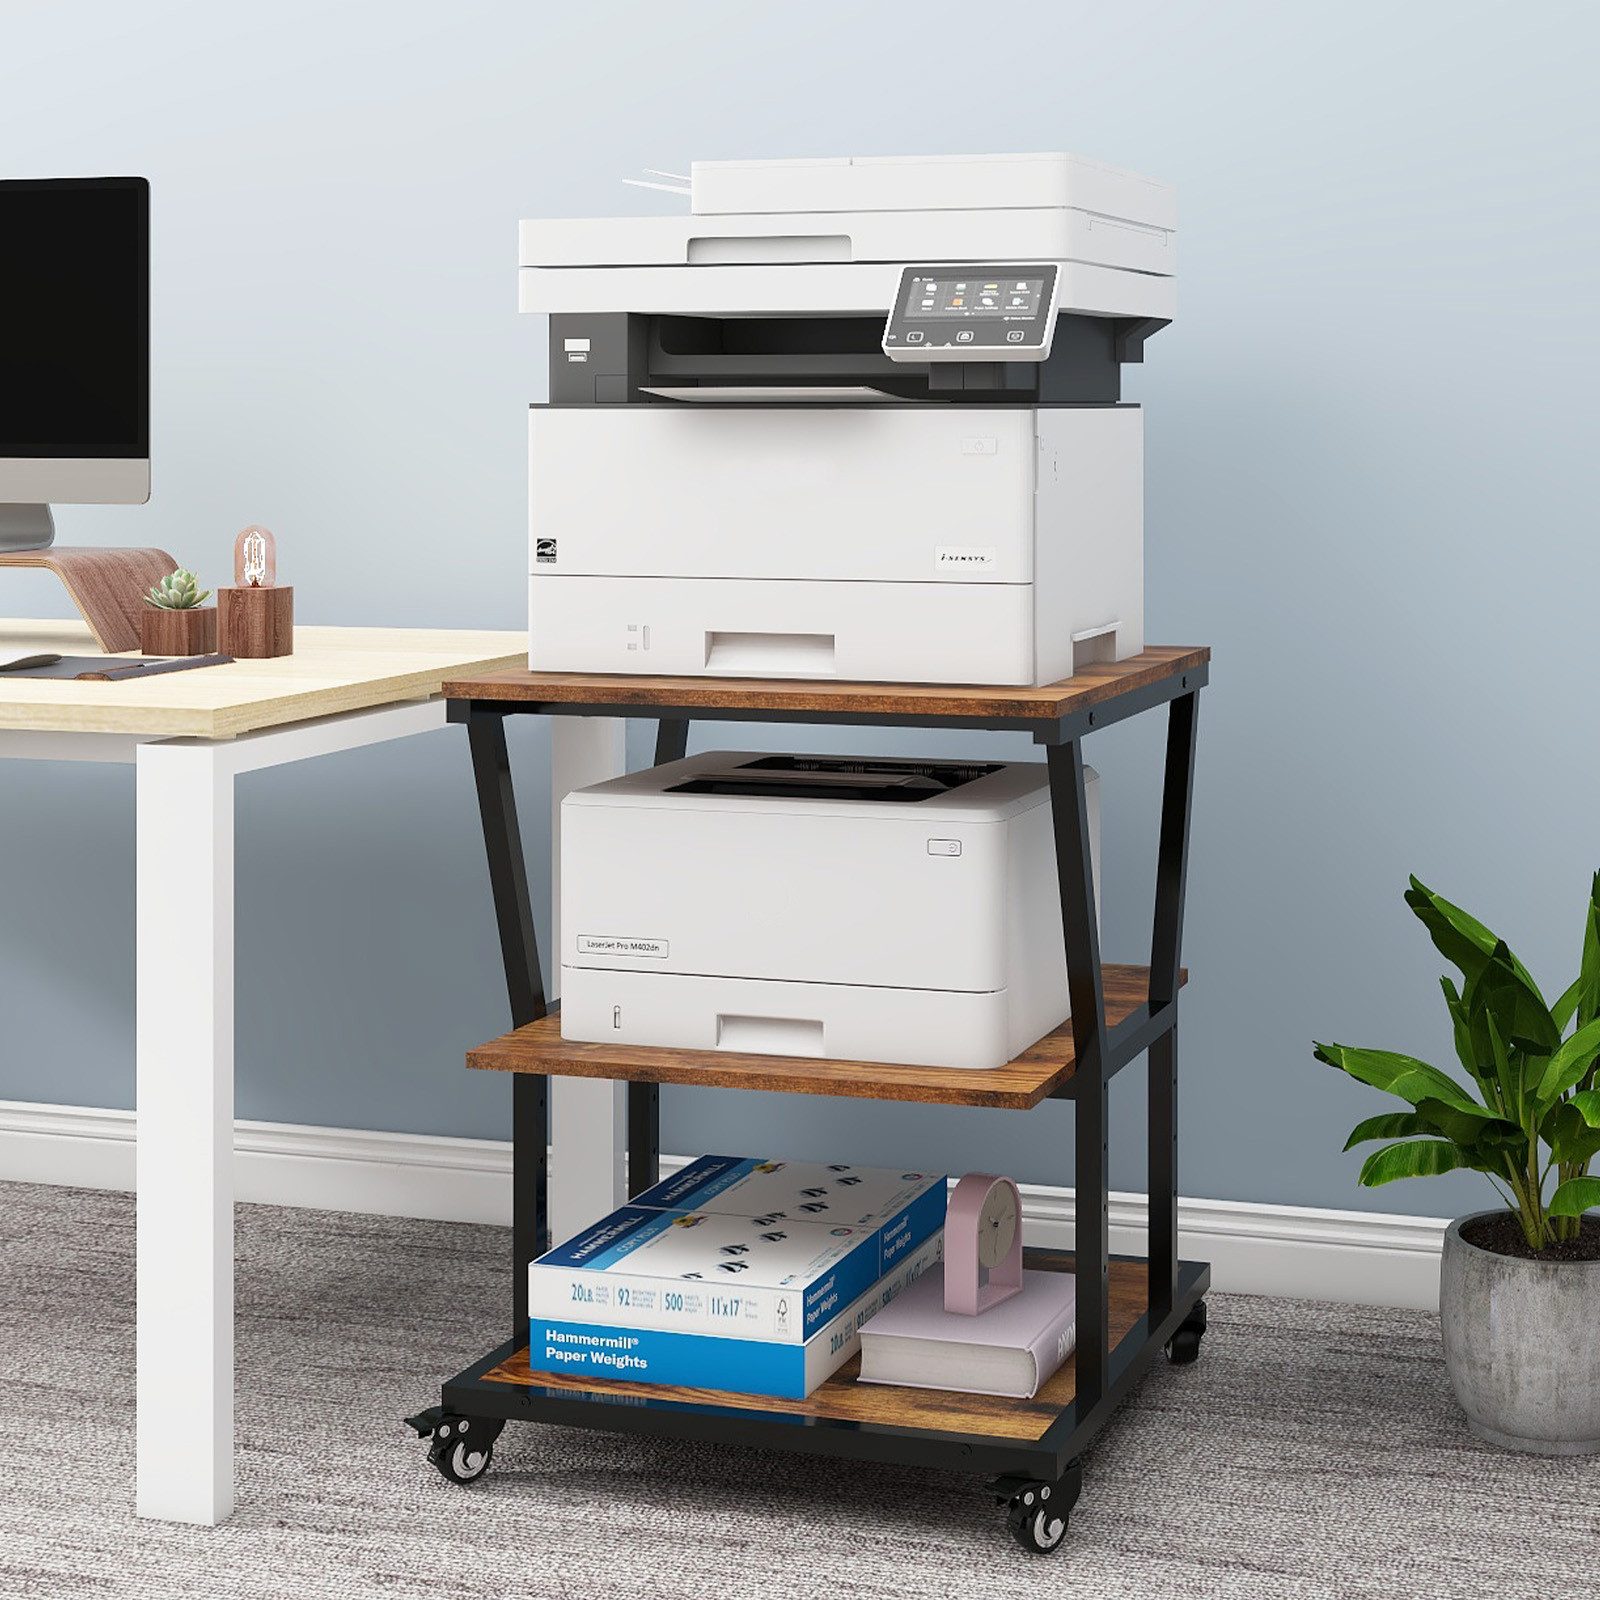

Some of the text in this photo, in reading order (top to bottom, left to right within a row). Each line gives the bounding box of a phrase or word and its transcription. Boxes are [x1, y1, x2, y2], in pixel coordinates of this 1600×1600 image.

[587, 941, 660, 952] LaserJet Pro M402dn
[618, 1288, 630, 1306] 92
[665, 1293, 684, 1312] 500
[545, 1347, 648, 1369] Paper Weights
